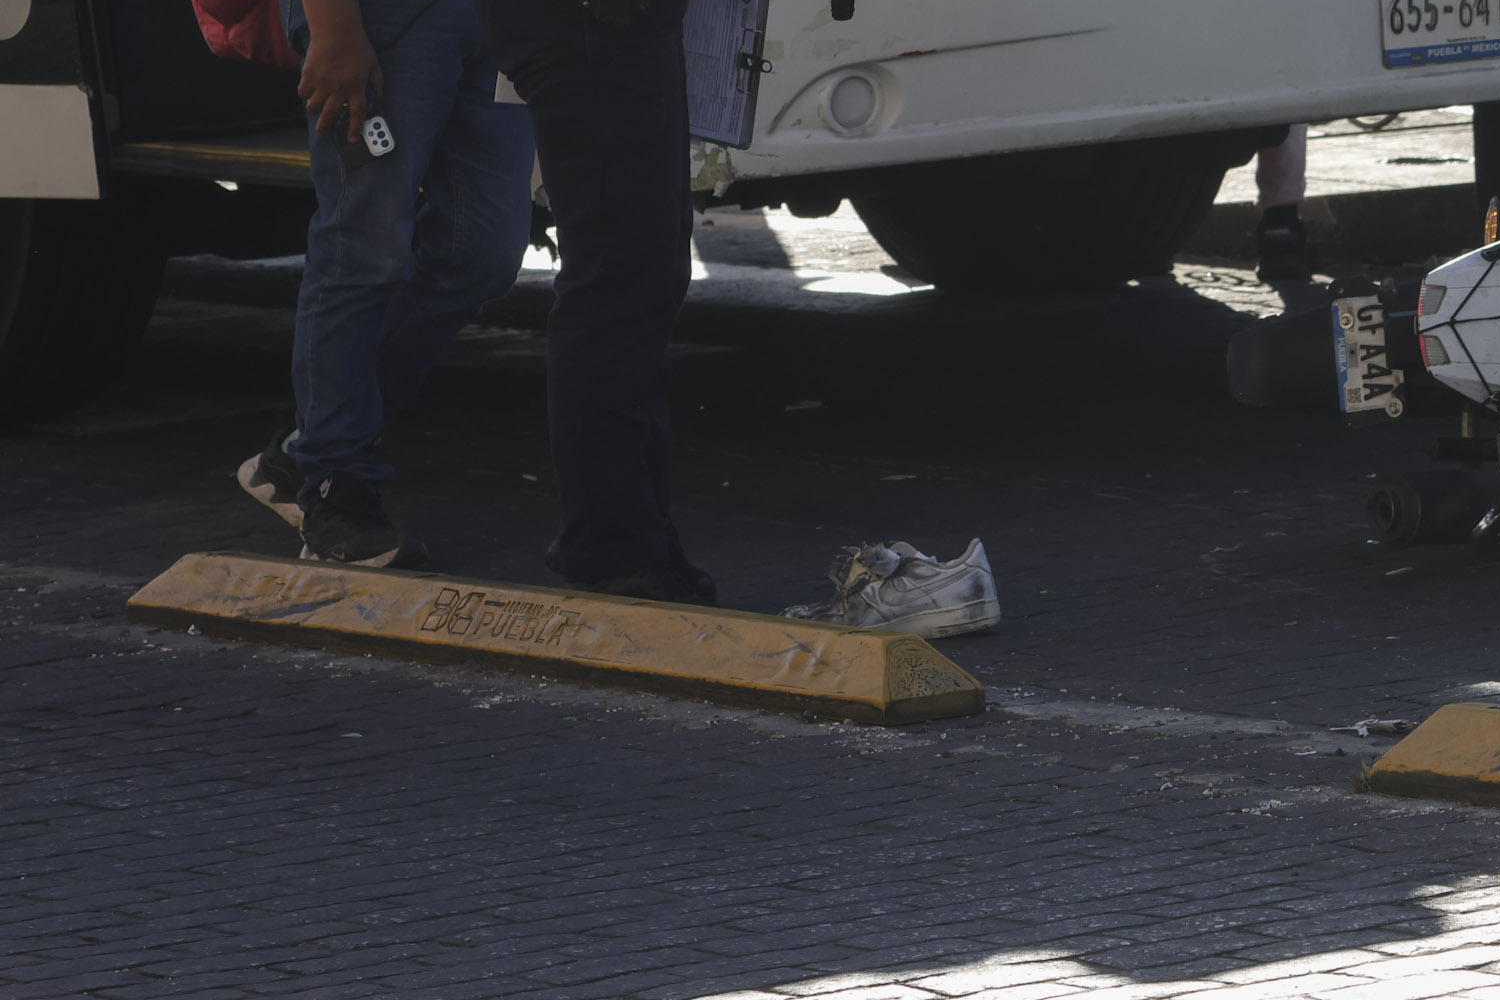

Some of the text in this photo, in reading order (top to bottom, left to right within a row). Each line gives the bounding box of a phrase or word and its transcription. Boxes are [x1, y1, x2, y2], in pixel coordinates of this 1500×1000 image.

[1427, 46, 1463, 58] PUEBLA
[1337, 337, 1348, 373] PUEBLA
[473, 611, 568, 646] PUEBLA
